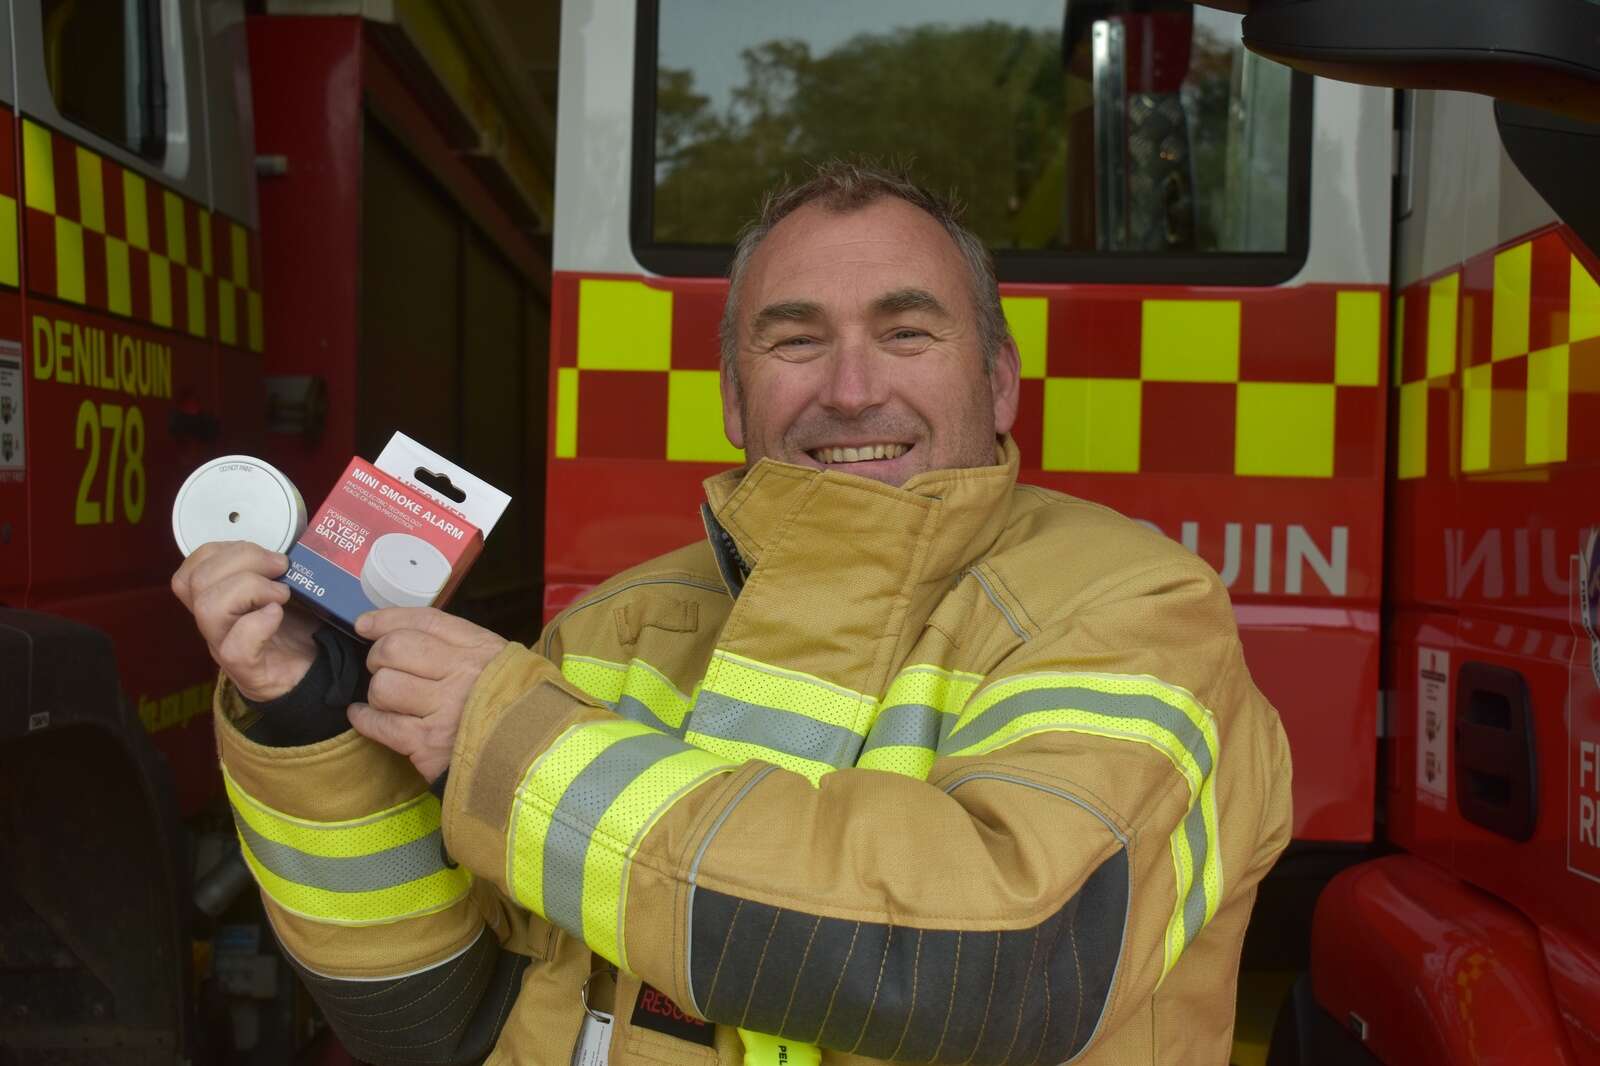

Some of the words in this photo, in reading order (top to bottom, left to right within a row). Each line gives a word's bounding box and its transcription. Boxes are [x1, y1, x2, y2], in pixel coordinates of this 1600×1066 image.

[32, 315, 172, 399] DENILIQUIN
[75, 399, 146, 525] 278
[351, 468, 380, 489] MINI
[379, 484, 423, 515] SMOKE
[422, 511, 465, 540] ALARM
[322, 516, 335, 528] 10
[337, 523, 366, 546] YEAR
[326, 508, 360, 532] POWERED
[359, 528, 370, 537] BY
[315, 523, 360, 554] BATTERY
[285, 568, 326, 597] LIFPE10
[291, 560, 315, 579] MODEL
